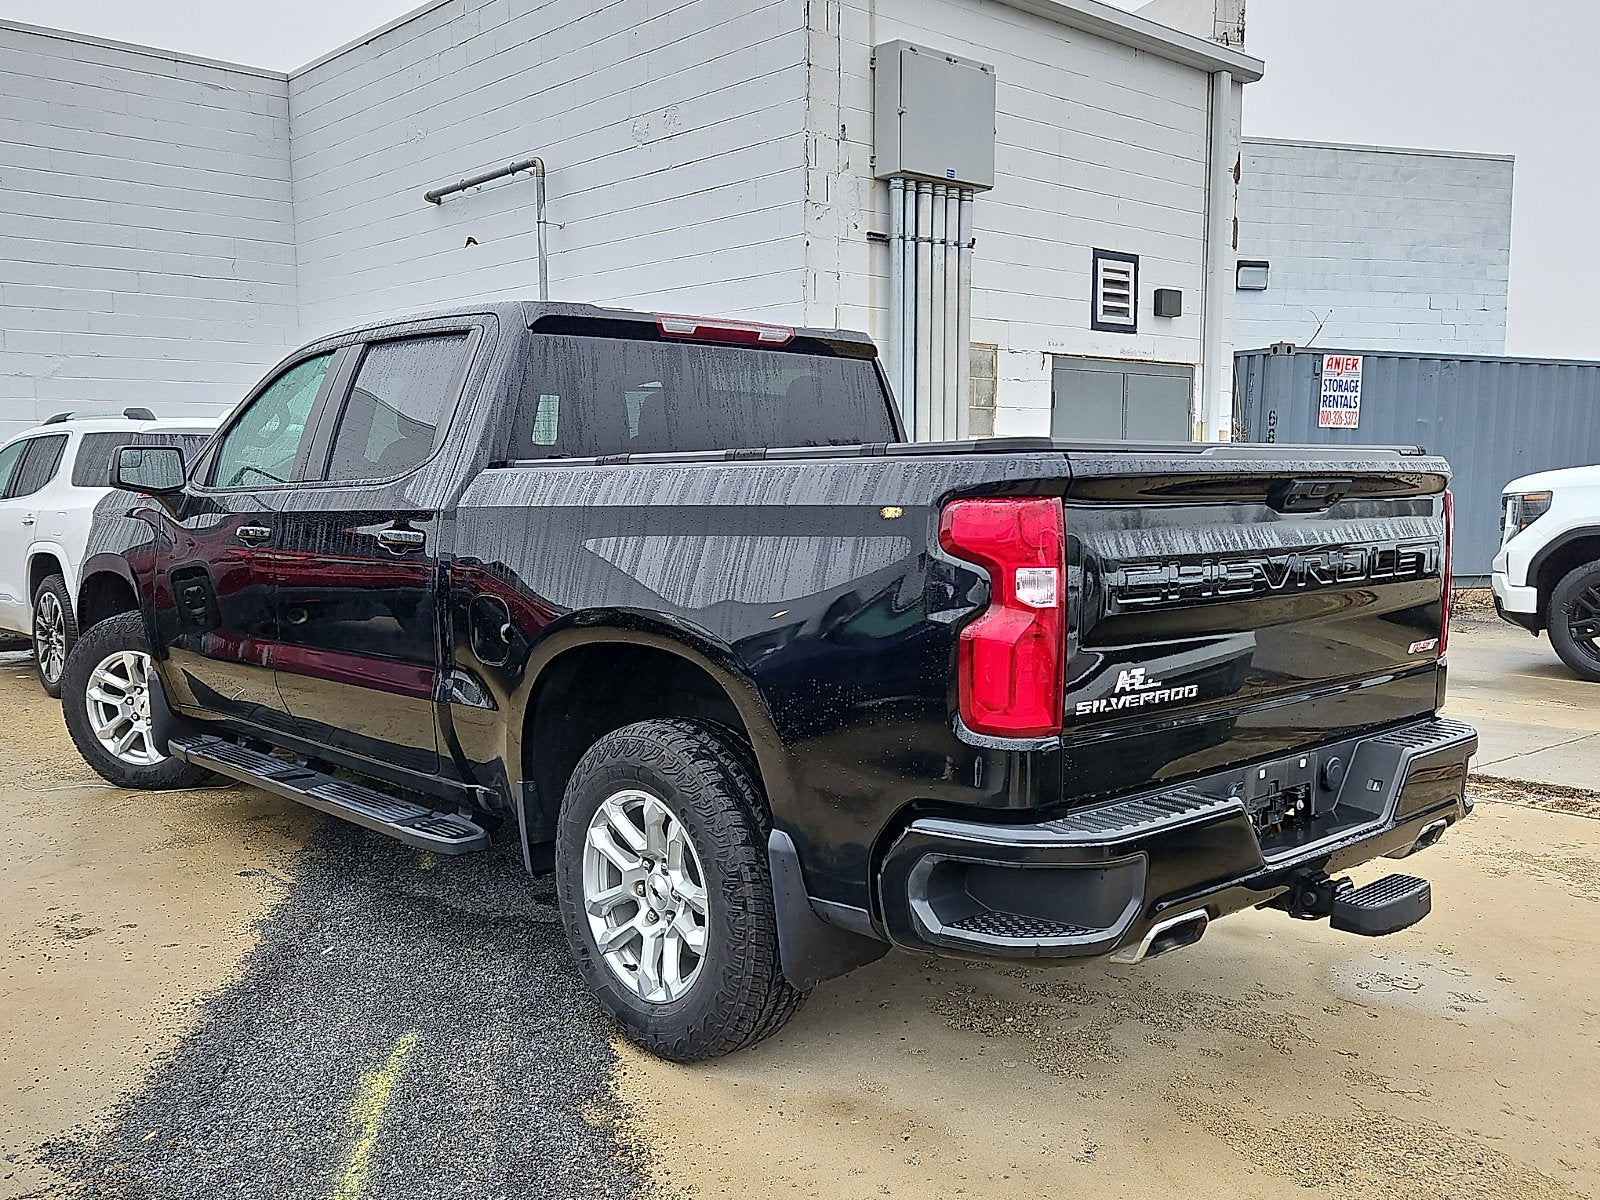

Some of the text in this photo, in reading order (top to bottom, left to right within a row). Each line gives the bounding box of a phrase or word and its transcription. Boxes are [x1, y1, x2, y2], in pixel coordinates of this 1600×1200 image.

[1326, 356, 1359, 376] ANJER
[1323, 379, 1360, 393] STORAGE
[1322, 395, 1358, 409] RENTALS
[1116, 543, 1439, 604] CHEVROLET
[1075, 685, 1199, 716] SILVERADO
